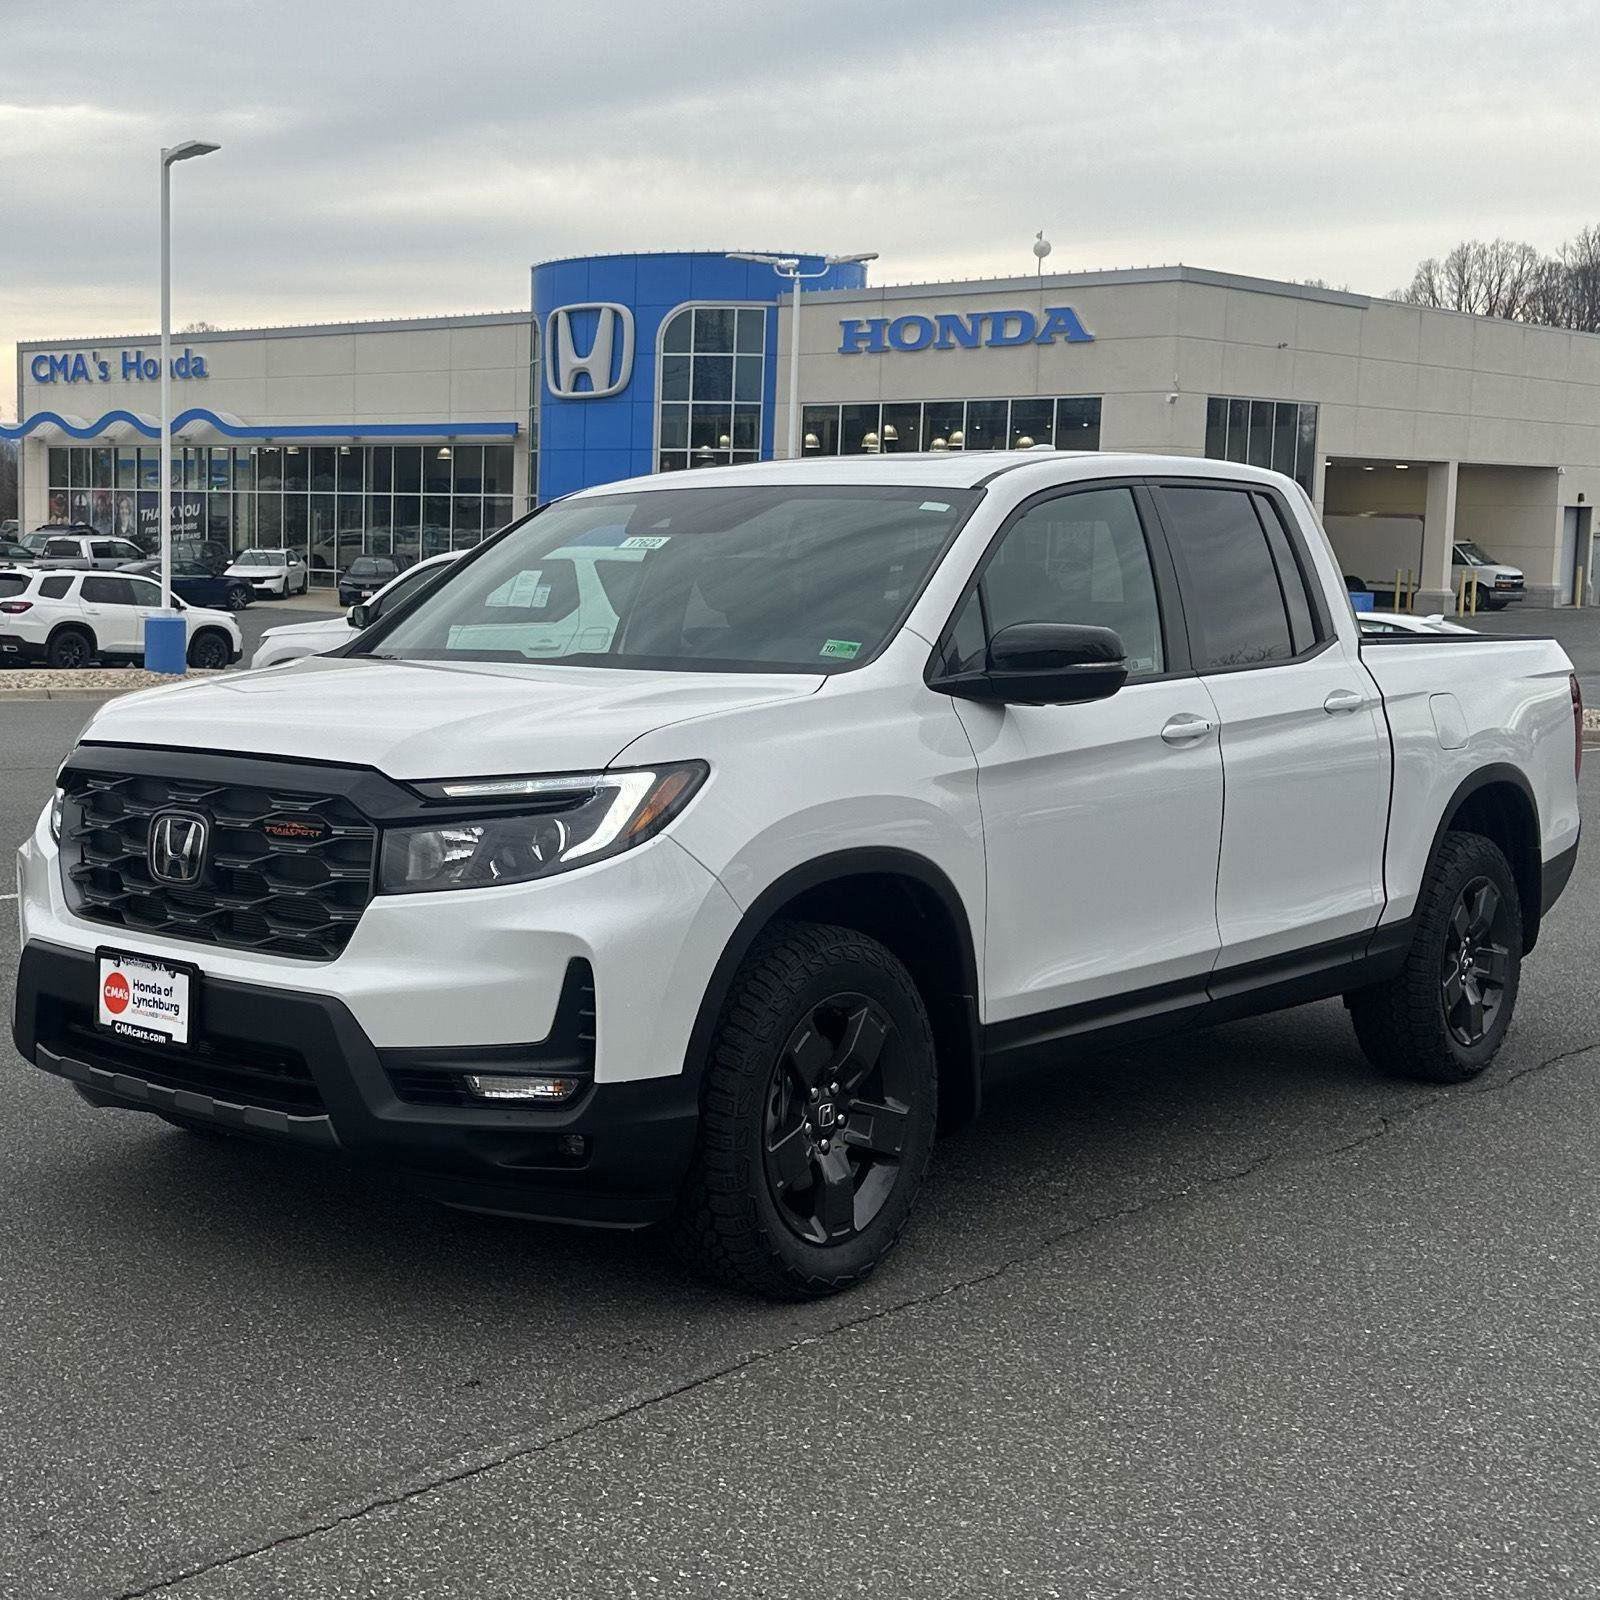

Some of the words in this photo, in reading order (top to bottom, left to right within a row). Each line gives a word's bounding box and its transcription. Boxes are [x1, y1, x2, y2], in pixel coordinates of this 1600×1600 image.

[837, 306, 1095, 354] HONDA
[31, 351, 110, 383] CMA's
[177, 503, 201, 518] YOU
[264, 826, 322, 838] TRAILSPORT
[104, 985, 129, 1001] CMA's
[132, 979, 162, 996] Honda
[163, 986, 174, 998] of
[132, 993, 180, 1016] Lynchburg
[115, 1022, 167, 1043] CMAcars.com
